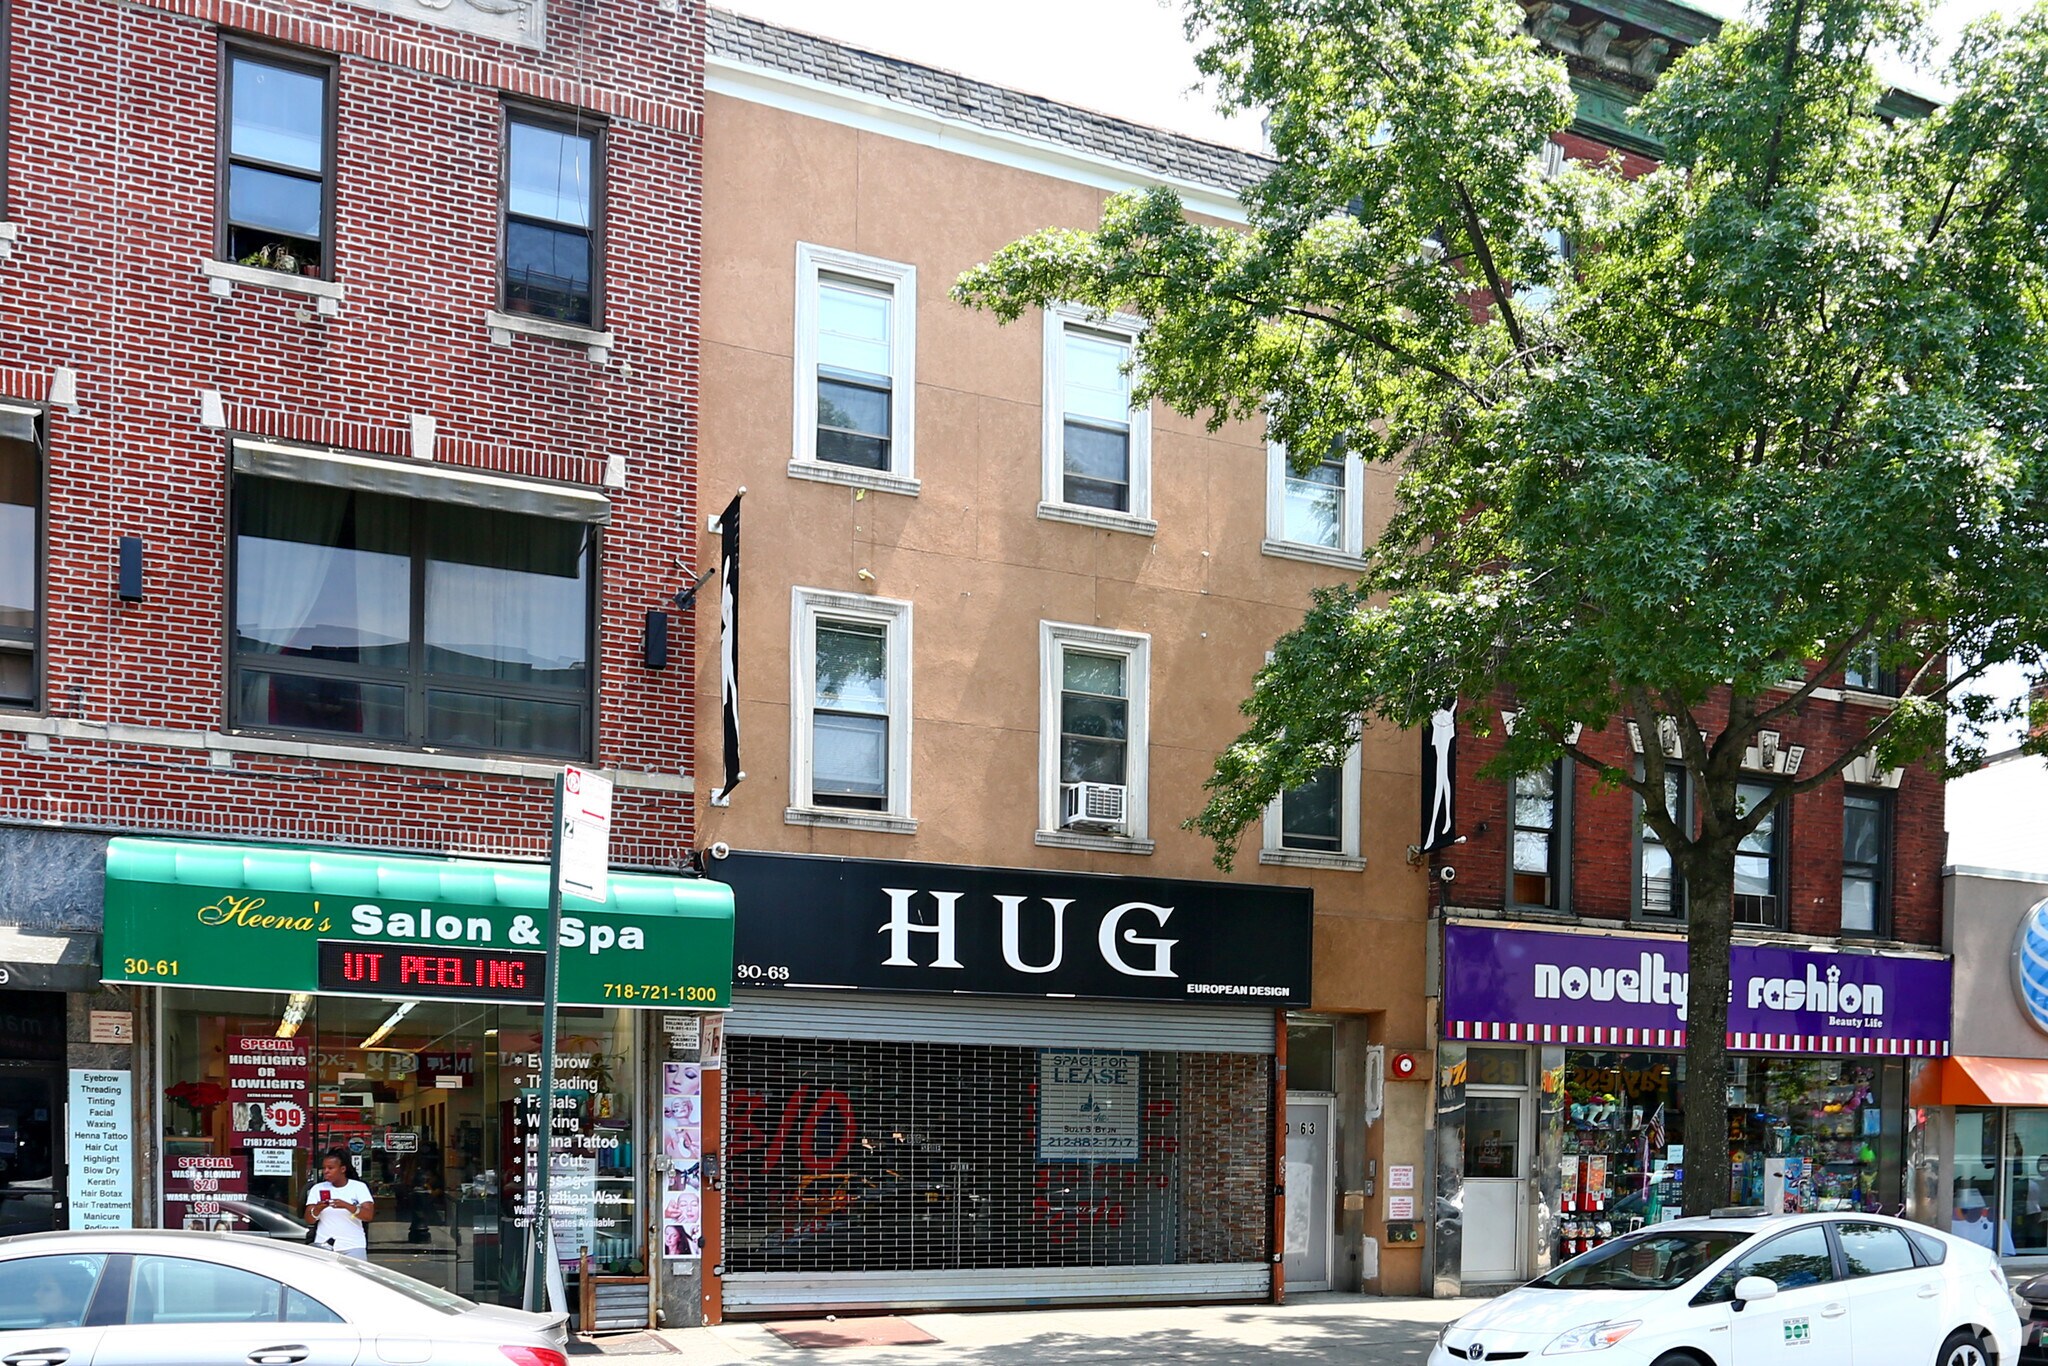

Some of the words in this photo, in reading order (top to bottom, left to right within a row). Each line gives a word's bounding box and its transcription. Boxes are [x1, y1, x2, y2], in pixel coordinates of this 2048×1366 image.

[198, 895, 331, 932] Heena's
[351, 904, 492, 942] Salon
[508, 915, 540, 945] &
[559, 922, 645, 954] Spa
[878, 888, 1179, 977] HUG
[124, 958, 179, 976] 30-61
[401, 956, 525, 989] PEELING
[738, 964, 790, 980] 30-63
[604, 984, 717, 1002] 718-721-1300
[1187, 983, 1248, 996] EUROPEAN
[1250, 986, 1290, 998] DESIGN
[1748, 963, 1883, 1015] fashion
[1828, 1016, 1862, 1029] Beauty
[1864, 1017, 1883, 1028] Life
[241, 1039, 294, 1051] SPECIAL
[229, 1055, 306, 1066] HIGHLIGHTS
[528, 1054, 590, 1071] Eybrow
[1053, 1056, 1098, 1067] SPACE
[1101, 1058, 1128, 1067] FOR
[84, 1073, 119, 1083] Eyebrow
[258, 1067, 276, 1077] OR
[1054, 1068, 1128, 1085] LEASE
[81, 1085, 122, 1095] Threading
[231, 1079, 305, 1089] LOWLIGHTS
[527, 1075, 598, 1093] Theading
[88, 1097, 115, 1107] Tinting
[527, 1094, 577, 1109] Faials
[89, 1109, 113, 1117] Facial
[267, 1108, 301, 1127] $99
[87, 1120, 116, 1130] Waxing
[527, 1114, 579, 1132] Wxing
[1301, 1122, 1315, 1135] 63
[103, 1132, 128, 1140] Tattoo
[575, 1134, 619, 1148] Tattoo
[85, 1143, 101, 1151] Hair
[84, 1155, 120, 1164] Highlight
[178, 1157, 233, 1168] SPECIAL
[527, 1153, 557, 1167] Hr
[559, 1153, 584, 1167] Cut
[84, 1166, 103, 1174] Blow
[106, 1167, 120, 1176] Dry
[194, 1179, 218, 1192] $20
[527, 1173, 588, 1189] Mssage
[91, 1201, 131, 1209] Treatment
[194, 1202, 219, 1213] $30
[1785, 1324, 1809, 1339] DOT
